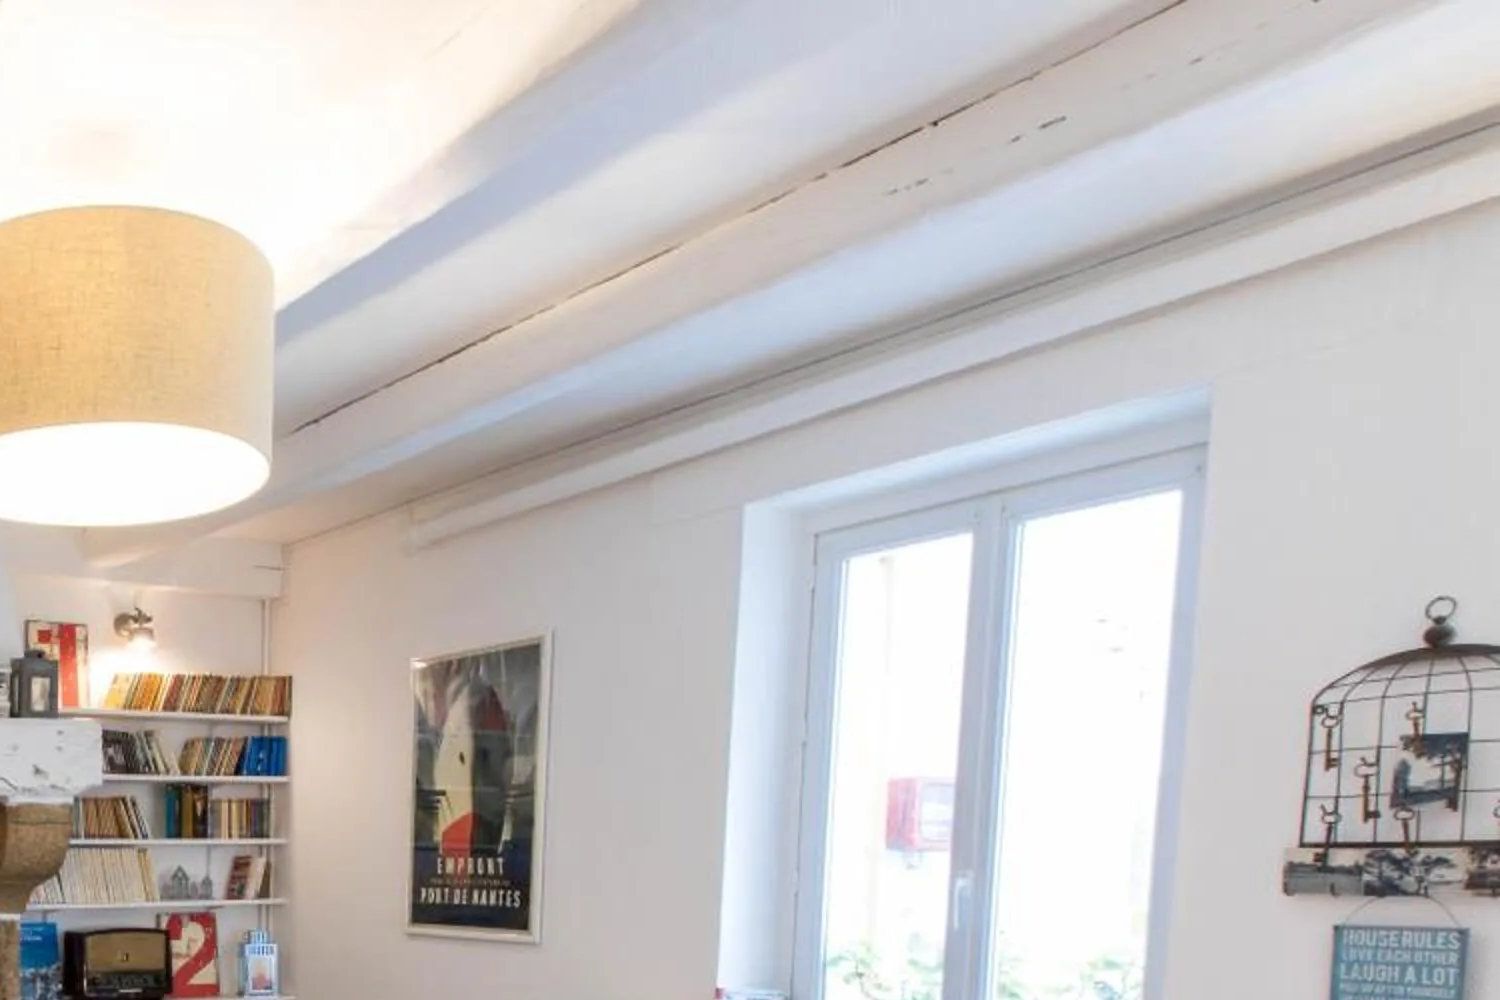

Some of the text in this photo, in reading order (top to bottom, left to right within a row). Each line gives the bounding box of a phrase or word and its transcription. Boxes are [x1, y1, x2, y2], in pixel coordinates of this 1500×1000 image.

[420, 887, 521, 908] PORT DE NANTES
[1343, 928, 1461, 949] HOUSE RULES
[166, 912, 219, 997] 2
[1342, 948, 1459, 965] LOVE EACH OTHER
[1340, 962, 1460, 986] LAUGH A LOT
